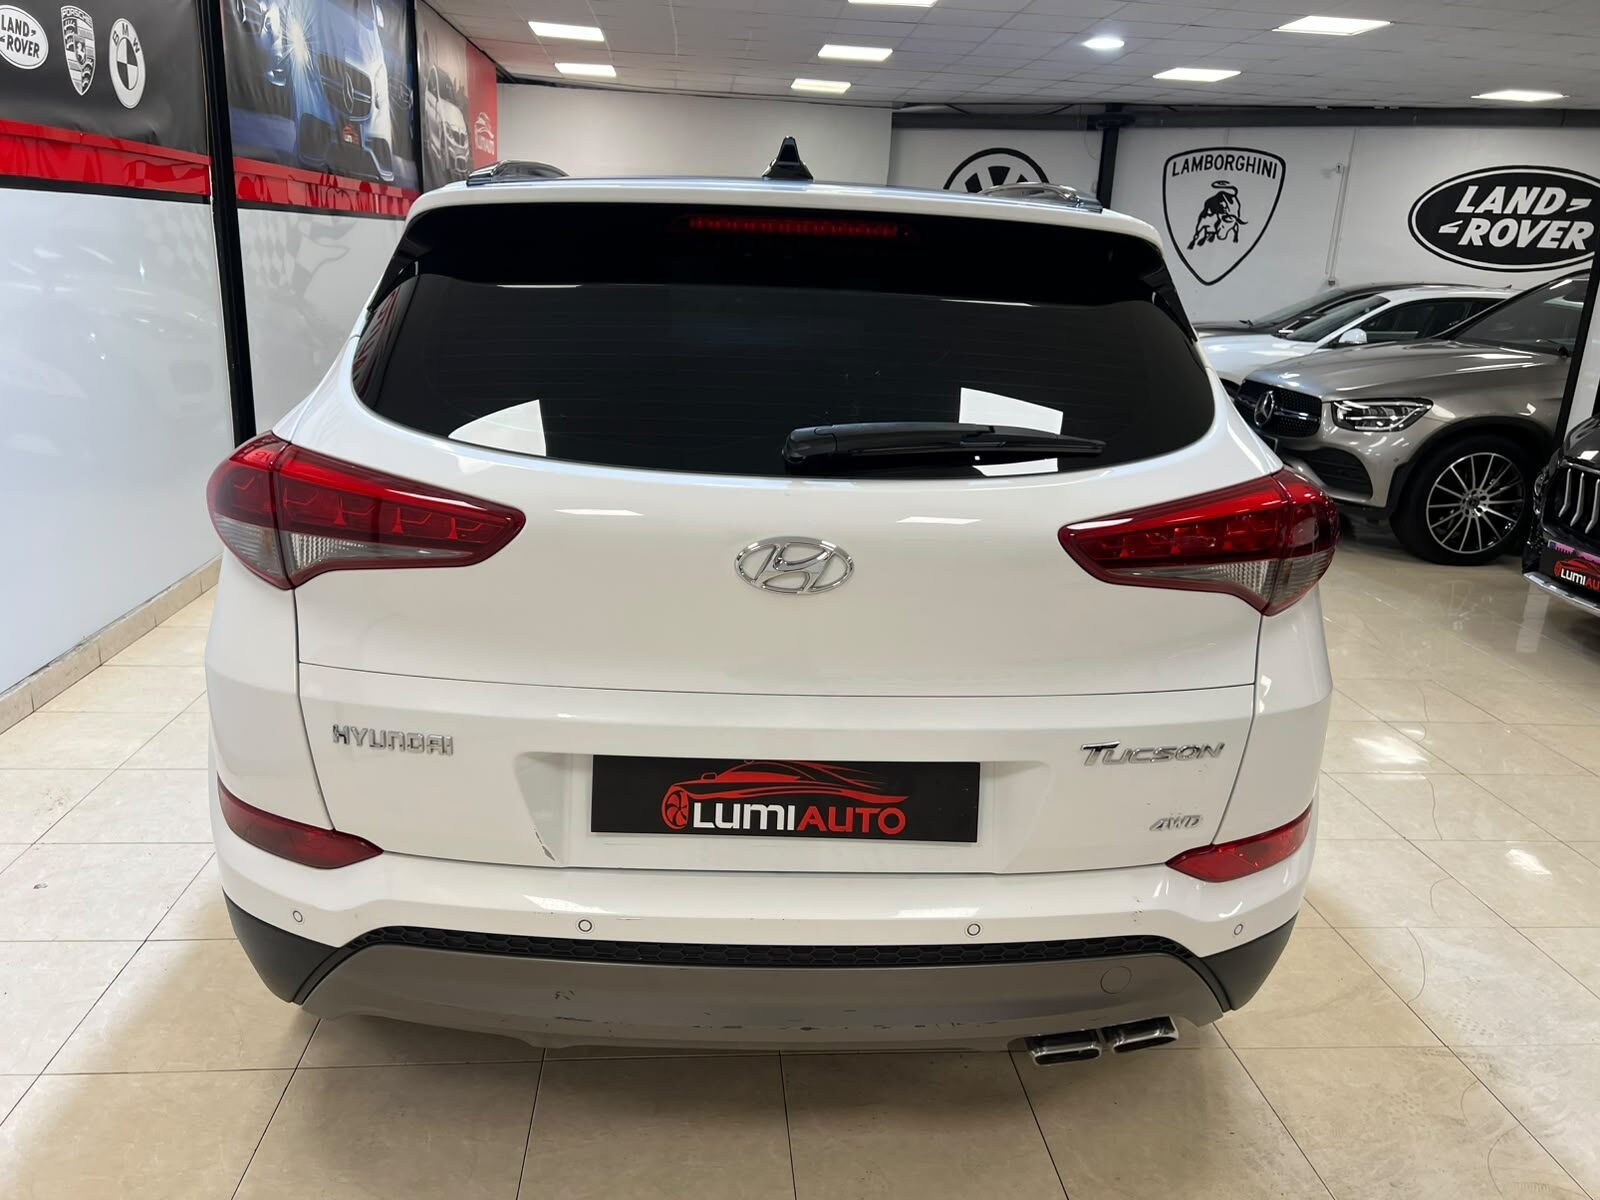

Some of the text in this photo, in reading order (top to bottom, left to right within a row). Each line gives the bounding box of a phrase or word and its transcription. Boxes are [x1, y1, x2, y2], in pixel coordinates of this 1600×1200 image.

[1, 14, 31, 38] LAND
[6, 35, 40, 59] ROVER
[1171, 153, 1278, 180] LAMBORGHINI
[1455, 185, 1567, 216] LAND
[1457, 217, 1595, 250] ROVER
[332, 724, 454, 756] HYUNDAI
